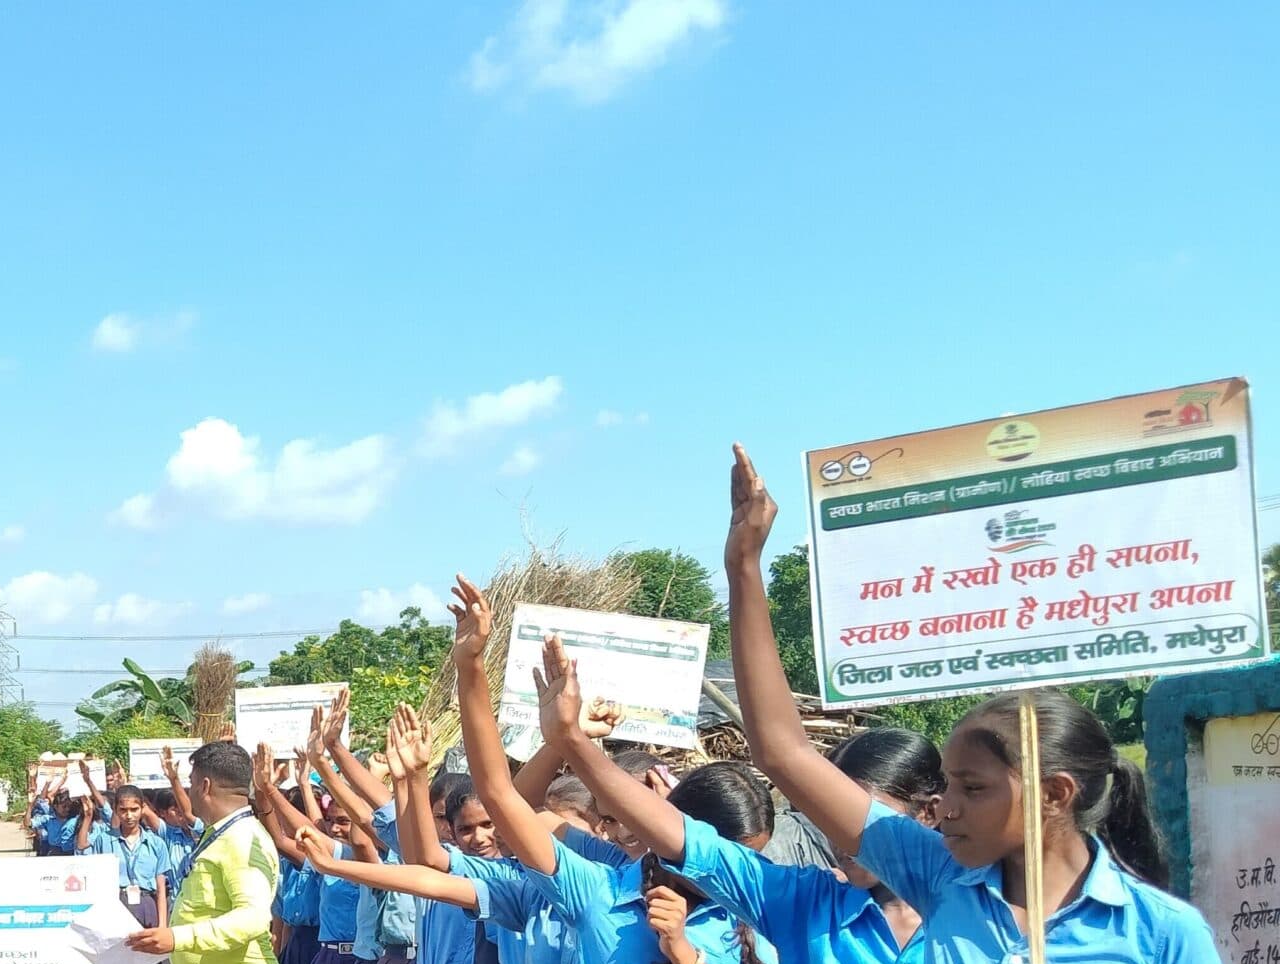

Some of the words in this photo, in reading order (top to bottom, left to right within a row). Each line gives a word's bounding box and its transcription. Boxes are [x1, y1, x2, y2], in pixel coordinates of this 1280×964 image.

[828, 502, 863, 518] स्वच्छ
[866, 497, 902, 513] भारत
[904, 489, 946, 507] मिशन
[1021, 470, 1070, 489] लोहिया
[1074, 463, 1111, 481] स्वच्छ
[1115, 457, 1156, 475] बिहार
[1159, 446, 1224, 467] अभियान
[860, 577, 905, 601] मन
[912, 566, 935, 594] में
[942, 557, 1002, 590] रखो
[1011, 556, 1059, 585] एक
[1066, 543, 1097, 579] ही
[1106, 538, 1199, 569] सपना,
[839, 620, 912, 647] स्वच्छ
[918, 608, 1008, 636] बनाना
[1016, 596, 1039, 629] है
[1044, 590, 1140, 626] मधेपुरा
[1149, 579, 1236, 609] अपना
[837, 662, 894, 686] जिला
[898, 658, 944, 679] जल
[946, 649, 983, 675] एवं
[984, 645, 1069, 670] स्वच्छता
[1074, 630, 1158, 660] समिति,
